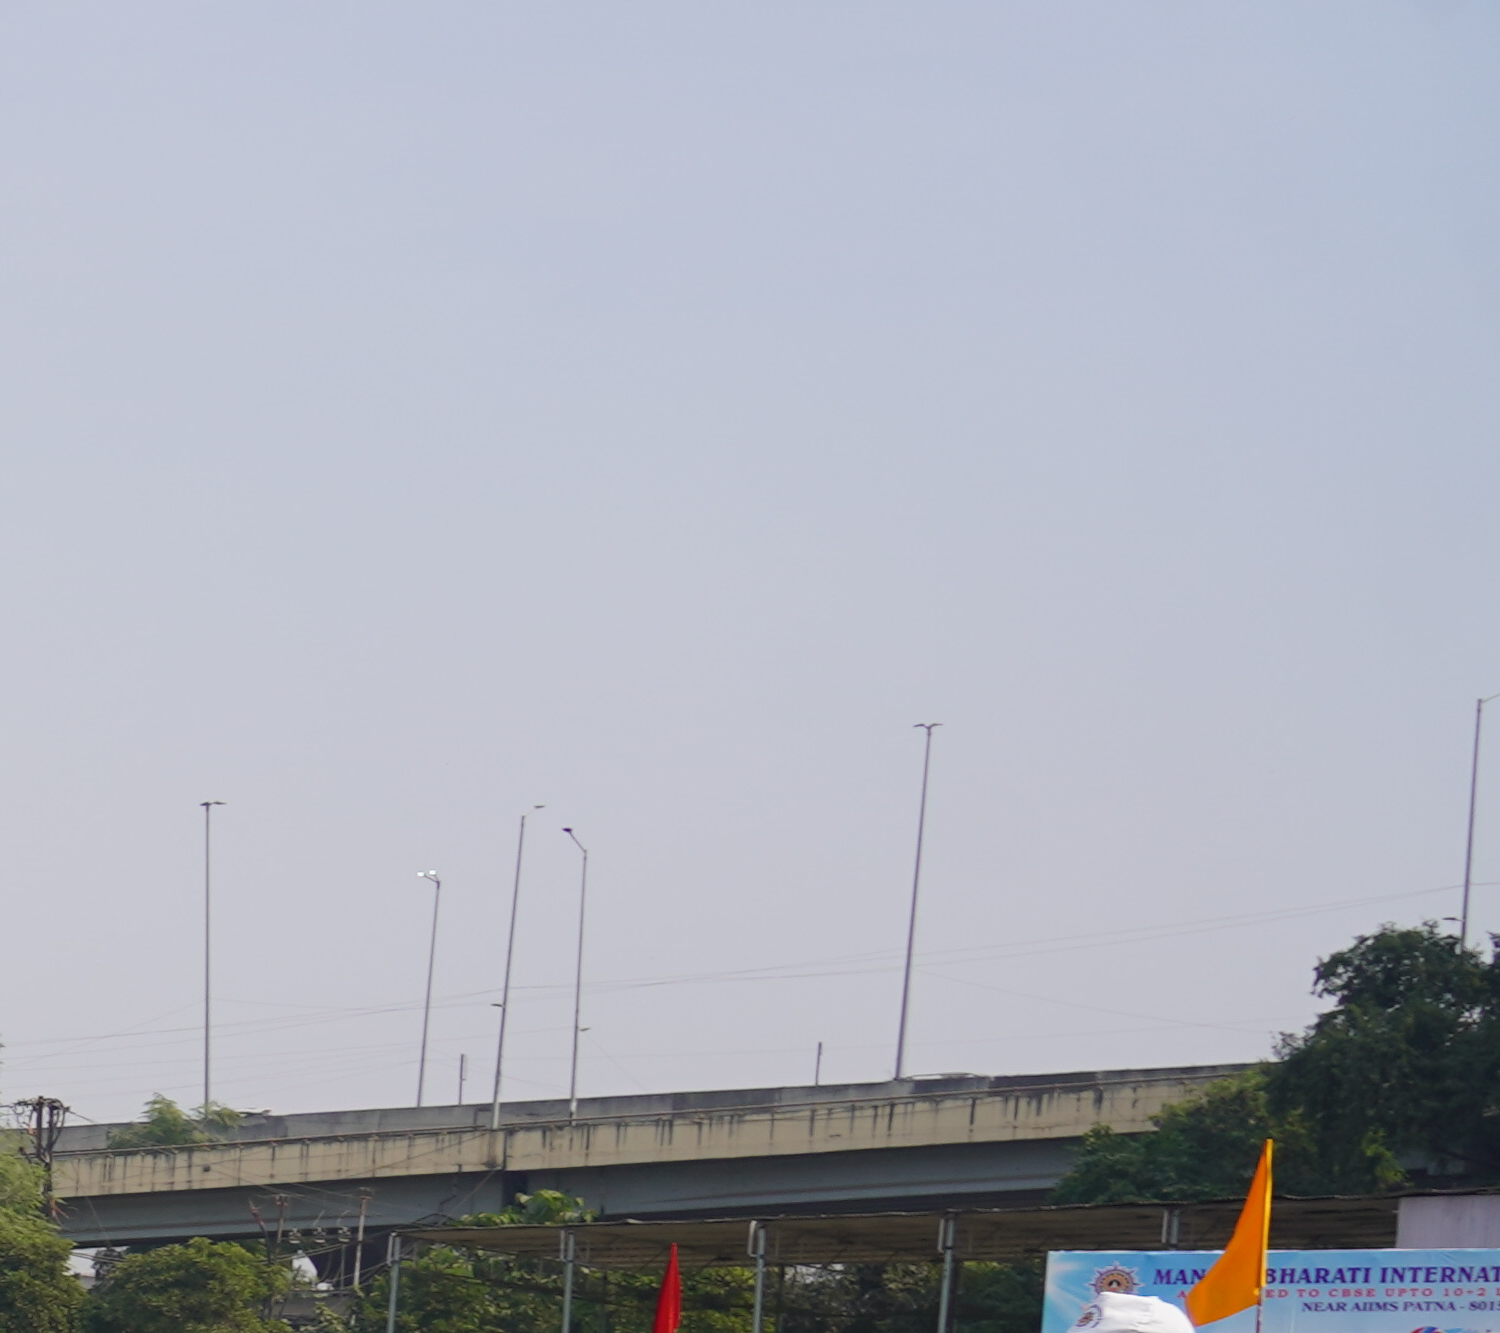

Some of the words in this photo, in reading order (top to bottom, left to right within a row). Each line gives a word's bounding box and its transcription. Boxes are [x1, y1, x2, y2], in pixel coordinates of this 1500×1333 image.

[1153, 1267, 1206, 1285] MAN
[1379, 1266, 1500, 1283] INTERNAT
[1296, 1288, 1320, 1298] TO
[1328, 1288, 1376, 1298] CBSE
[1385, 1287, 1433, 1298] UPTO
[1301, 1301, 1347, 1312] NEAR
[1351, 1301, 1399, 1312] AIIMS
[1403, 1301, 1457, 1311] PATNA
